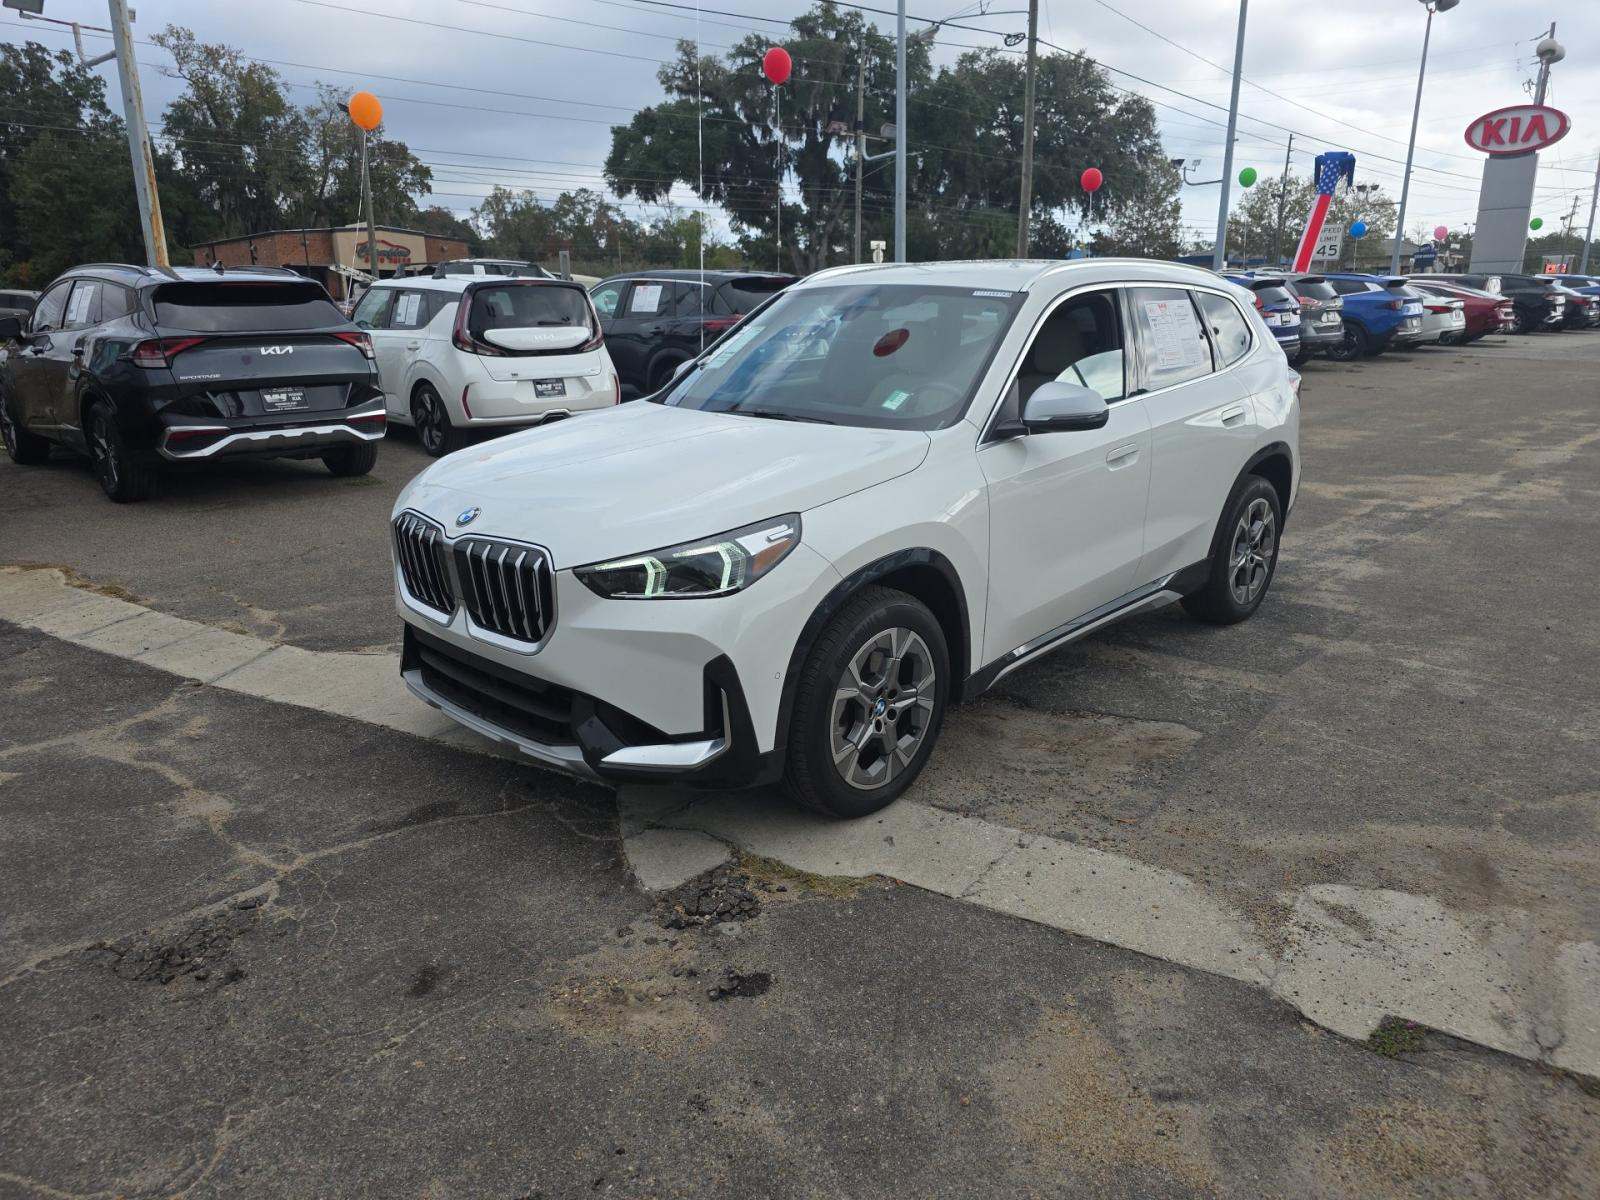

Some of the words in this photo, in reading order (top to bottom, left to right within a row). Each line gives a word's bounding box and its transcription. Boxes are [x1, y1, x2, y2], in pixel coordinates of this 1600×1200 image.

[1481, 114, 1548, 146] KIA
[1316, 244, 1338, 257] 45
[261, 345, 294, 355] KIA
